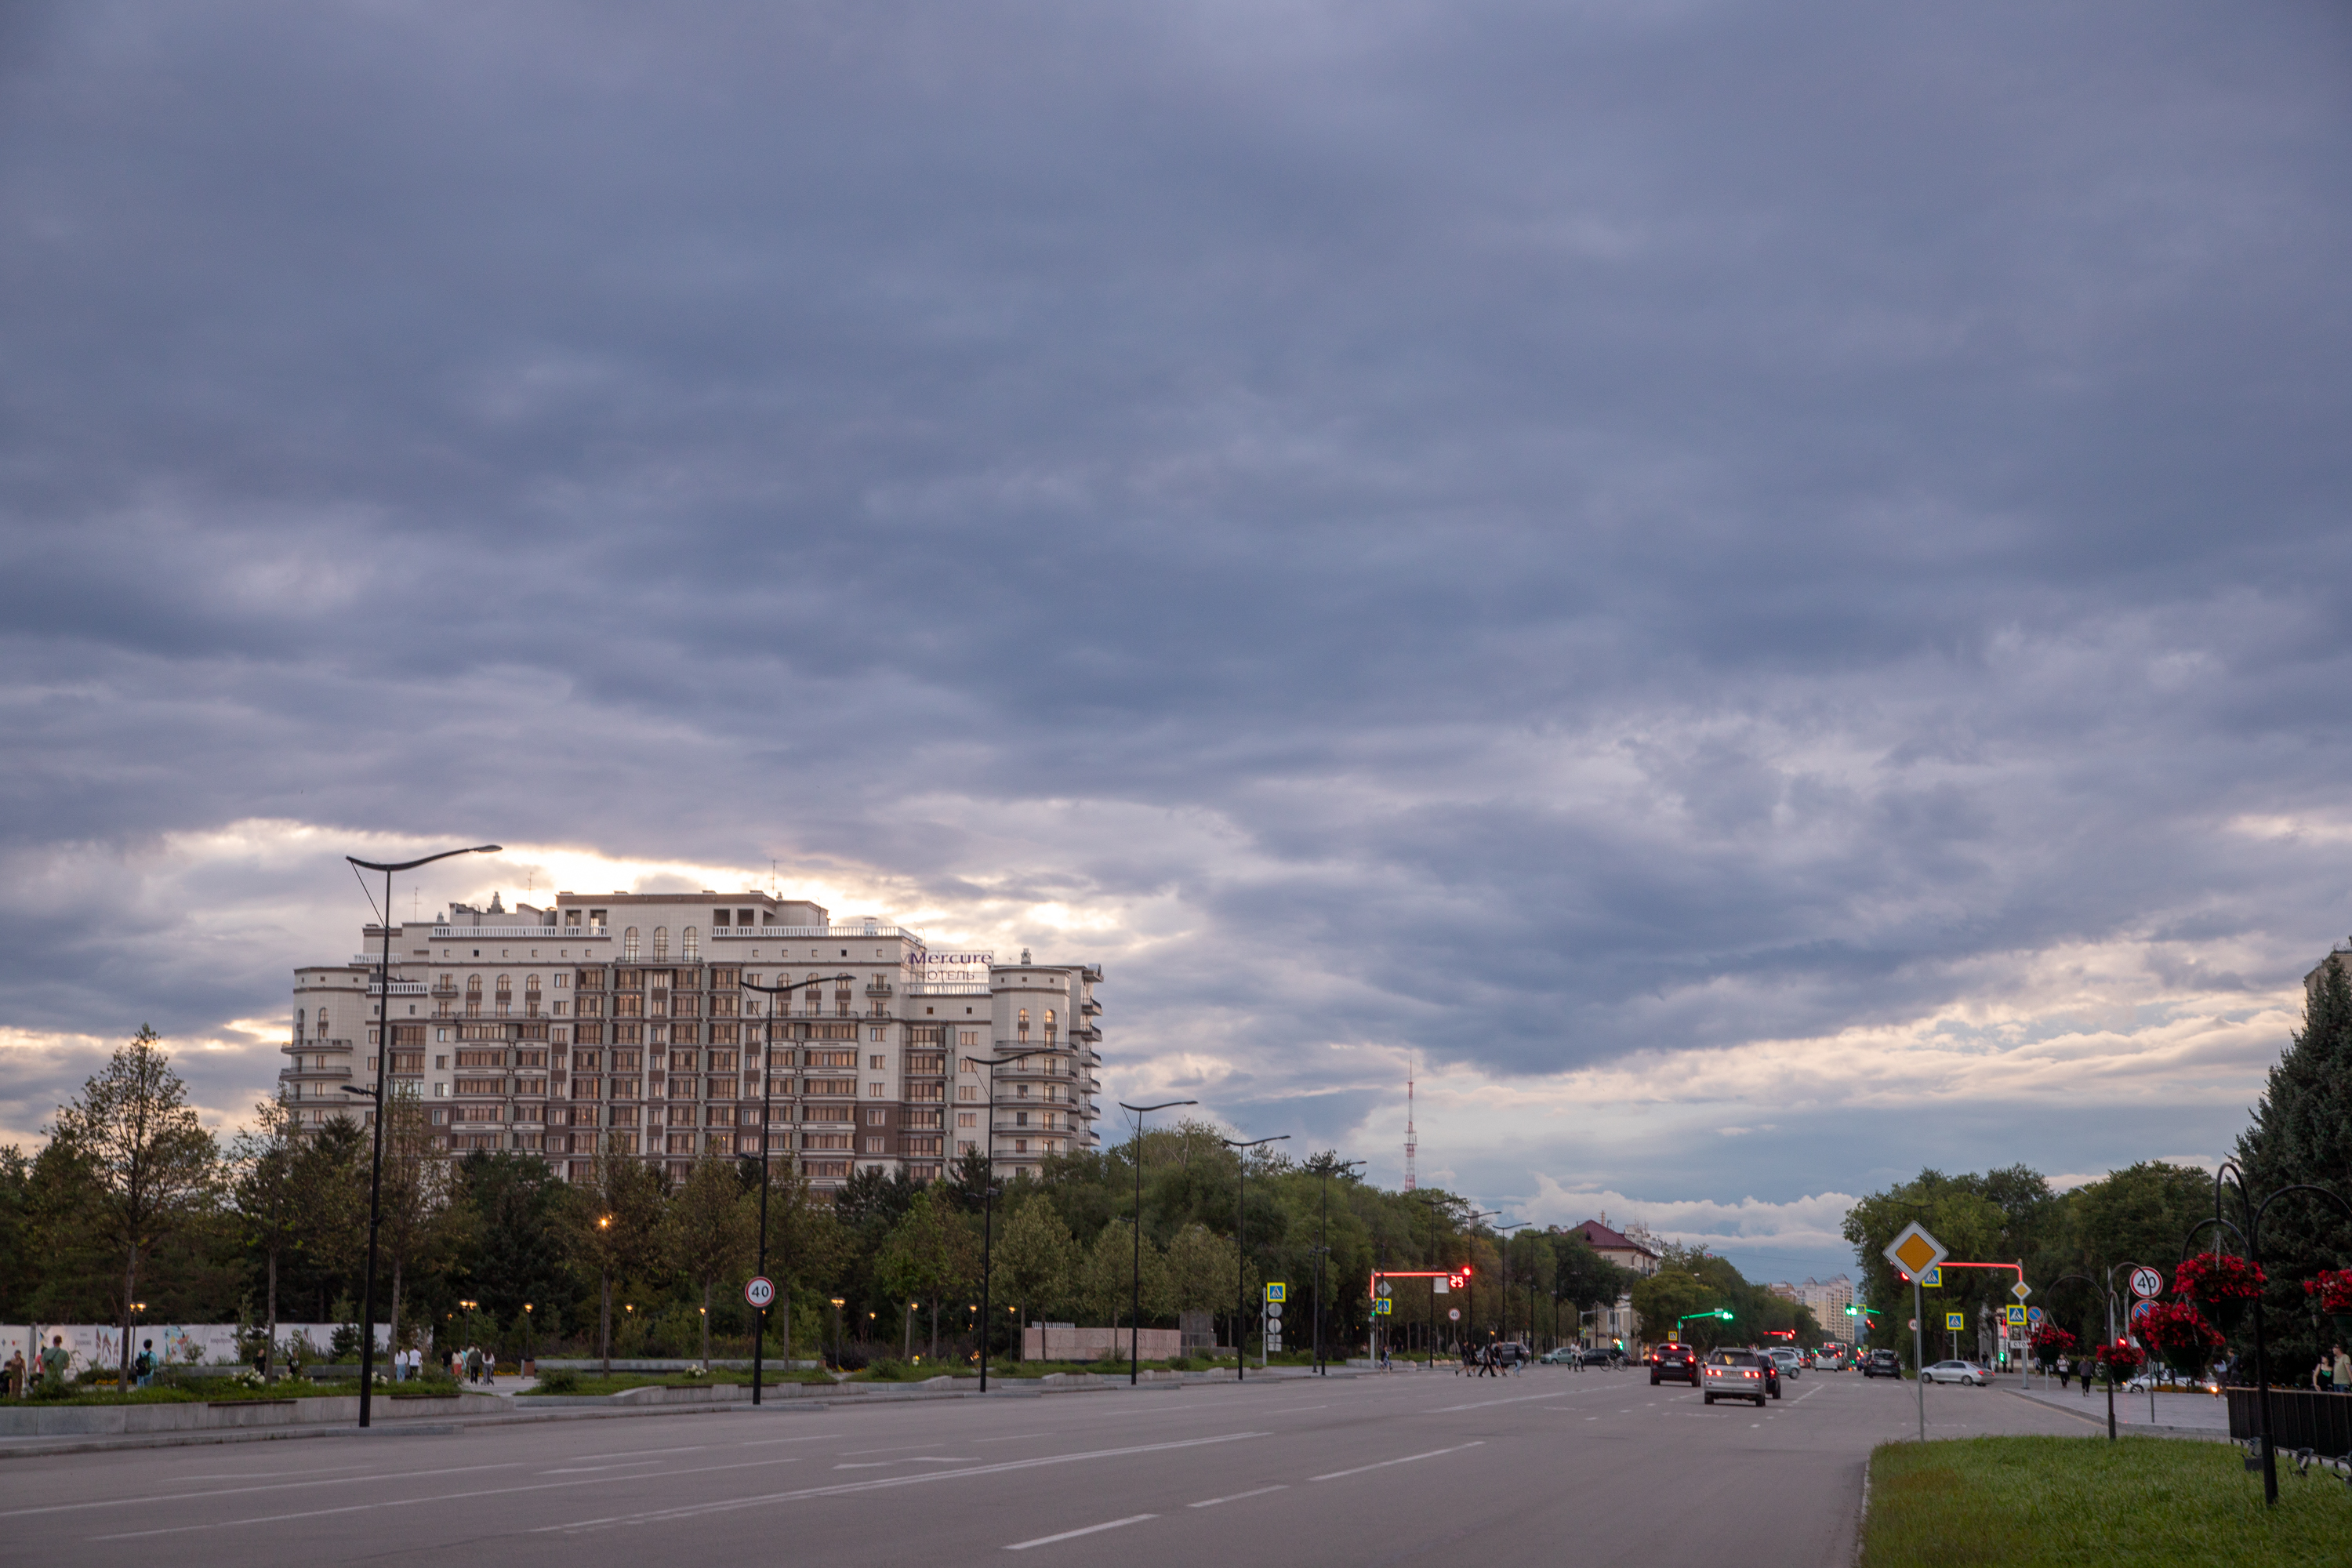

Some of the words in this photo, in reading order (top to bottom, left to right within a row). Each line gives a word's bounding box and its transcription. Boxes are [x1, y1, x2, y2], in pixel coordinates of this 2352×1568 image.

[910, 952, 993, 964] Mercure
[927, 970, 975, 981] ОТЕЛЬ
[2137, 1276, 2157, 1289] 40
[751, 1286, 769, 1298] 40
